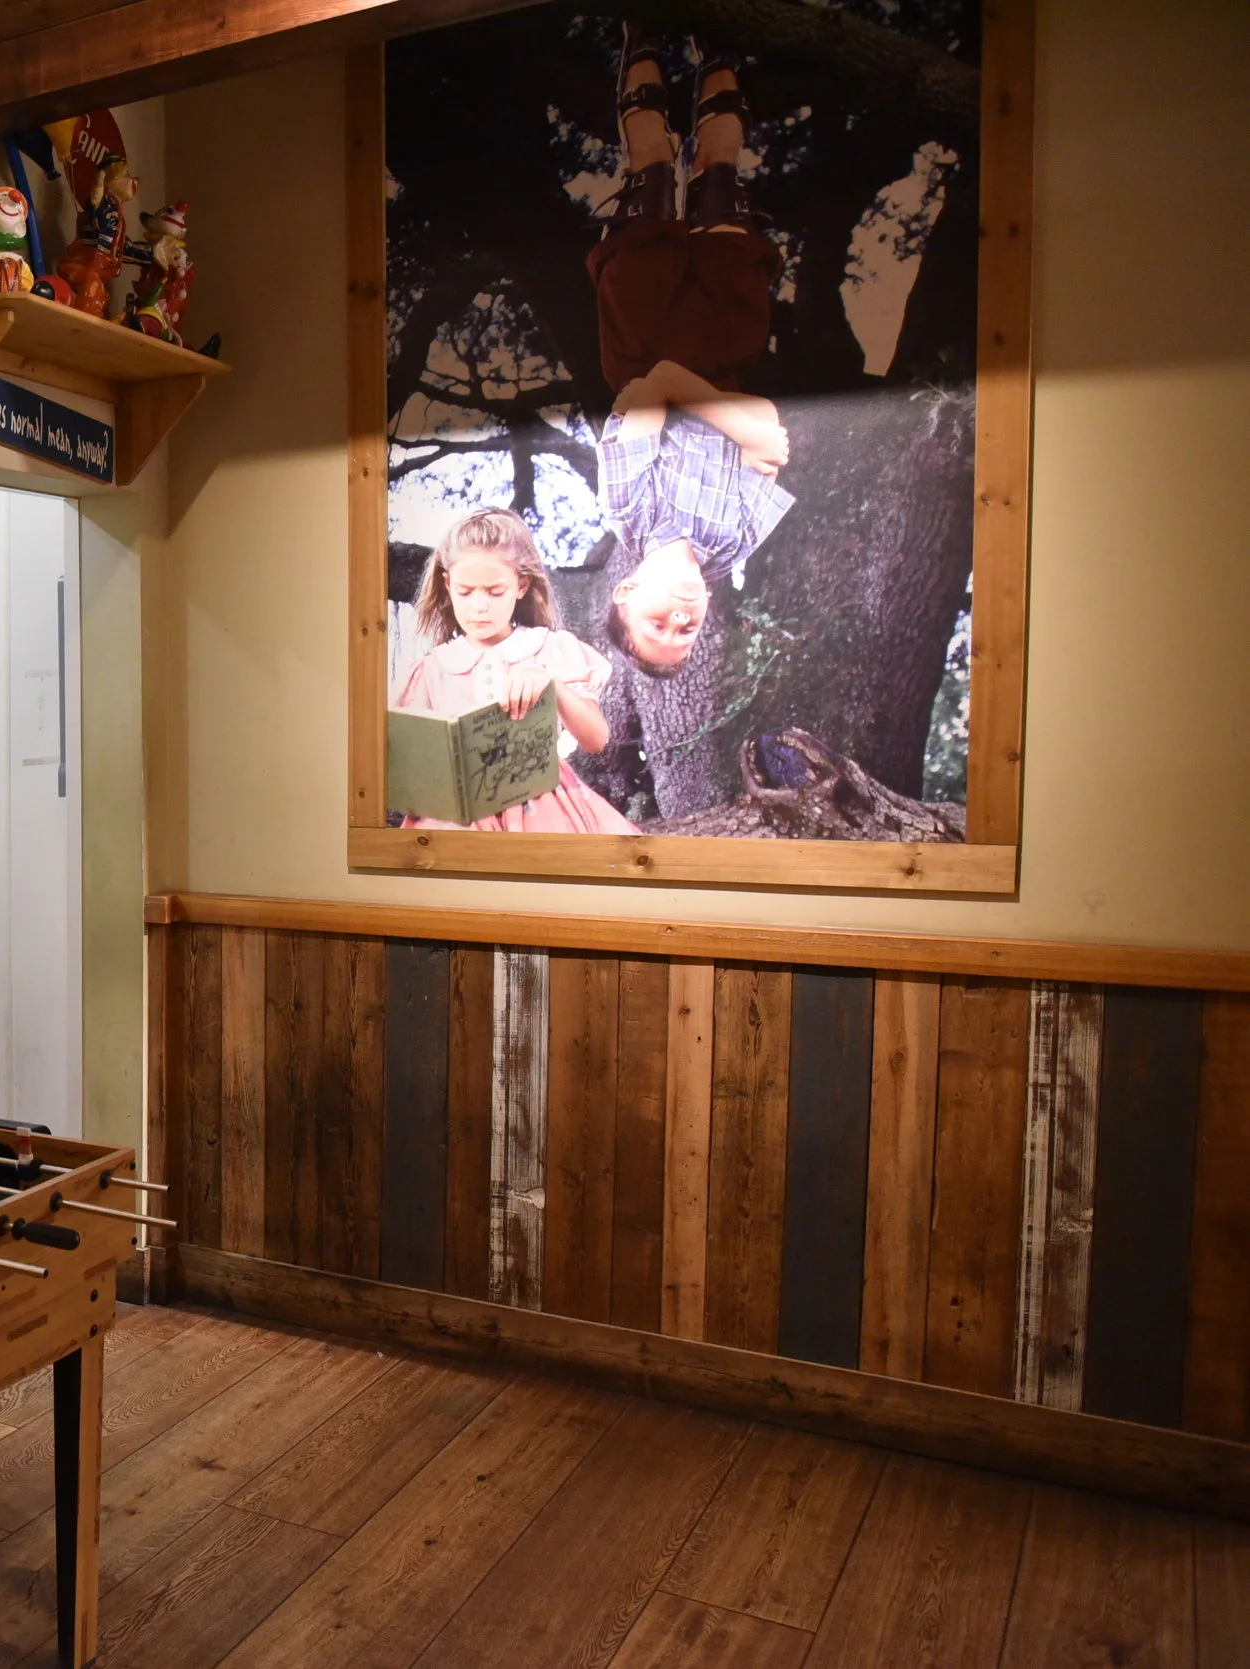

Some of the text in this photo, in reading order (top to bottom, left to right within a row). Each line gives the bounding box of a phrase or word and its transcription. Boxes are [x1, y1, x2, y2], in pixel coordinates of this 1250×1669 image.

[10, 401, 44, 446] normal
[47, 424, 73, 461] mean,
[76, 430, 109, 474] anyway?
